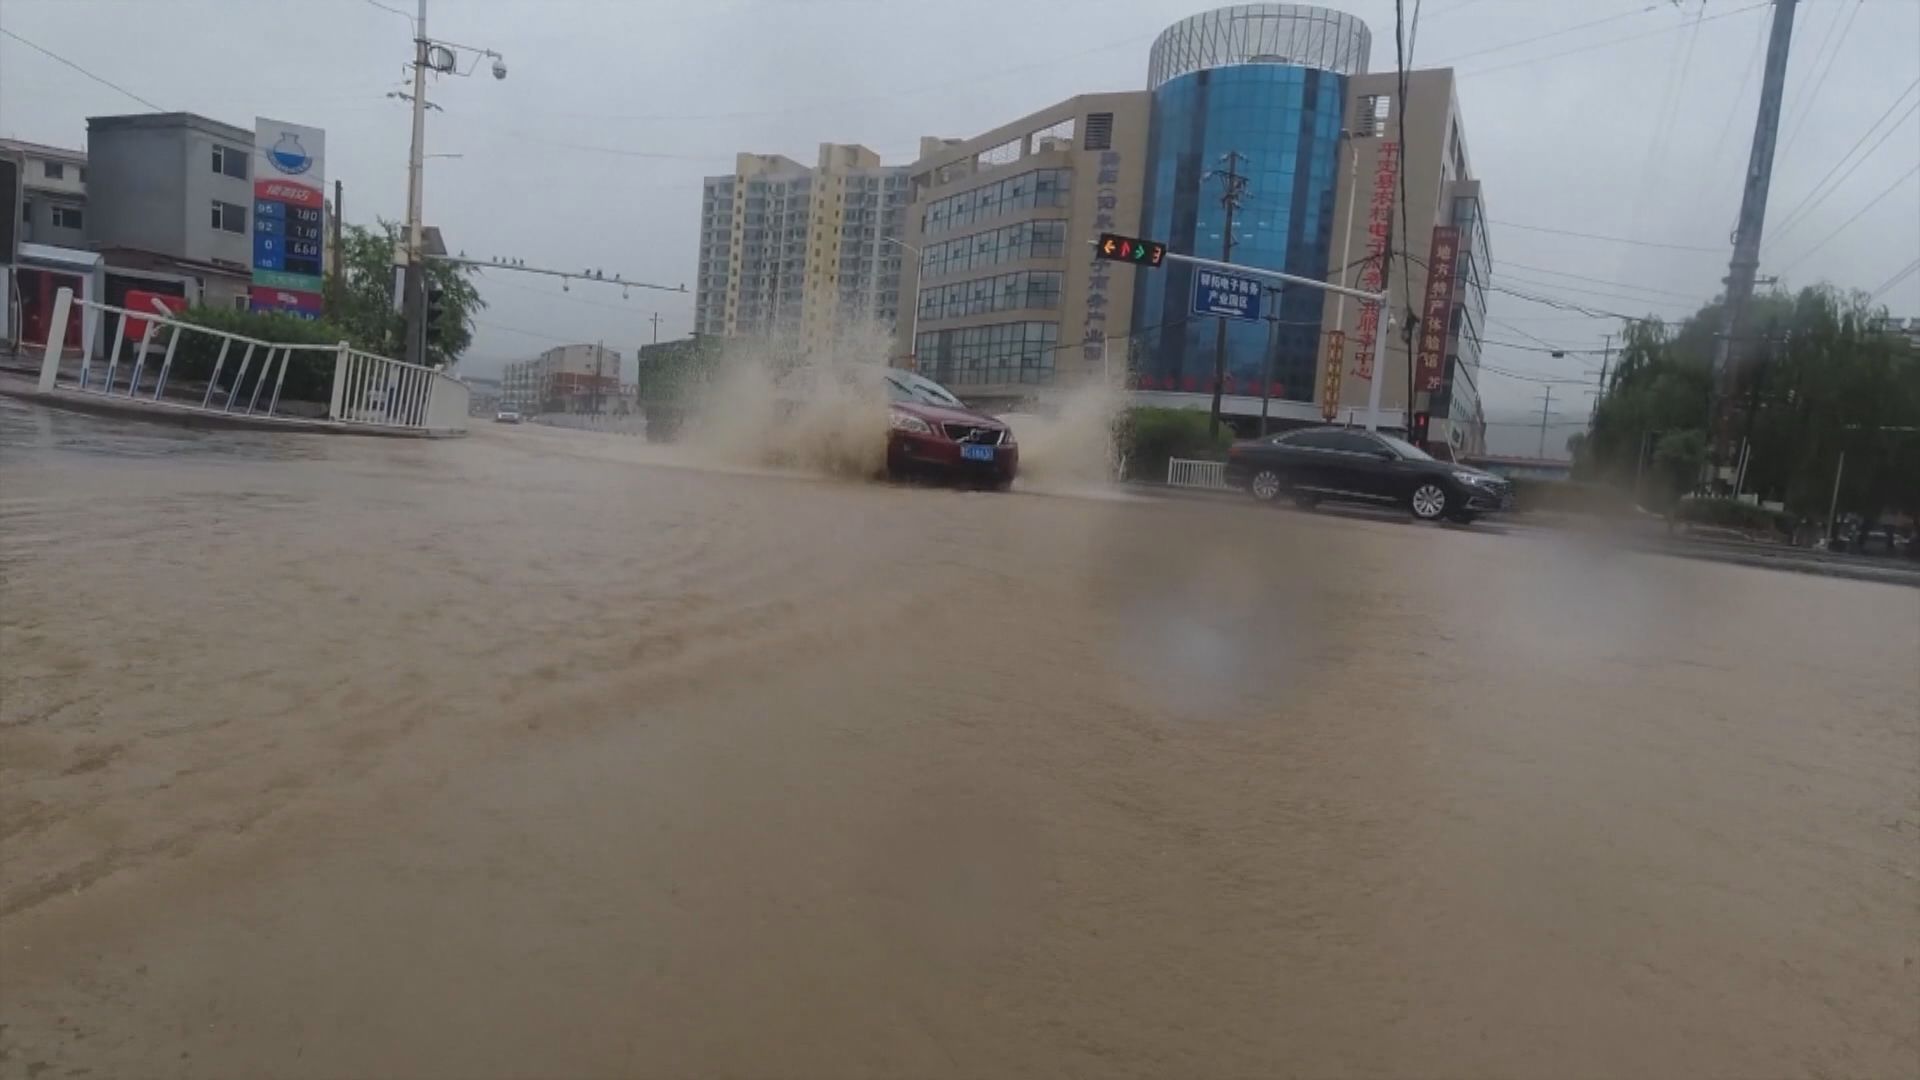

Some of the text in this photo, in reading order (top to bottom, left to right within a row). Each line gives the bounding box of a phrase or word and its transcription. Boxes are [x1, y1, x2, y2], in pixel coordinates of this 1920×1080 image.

[258, 220, 272, 231] 92
[1419, 244, 1451, 368] 地方特产体验馆
[1427, 377, 1440, 389] 2F
